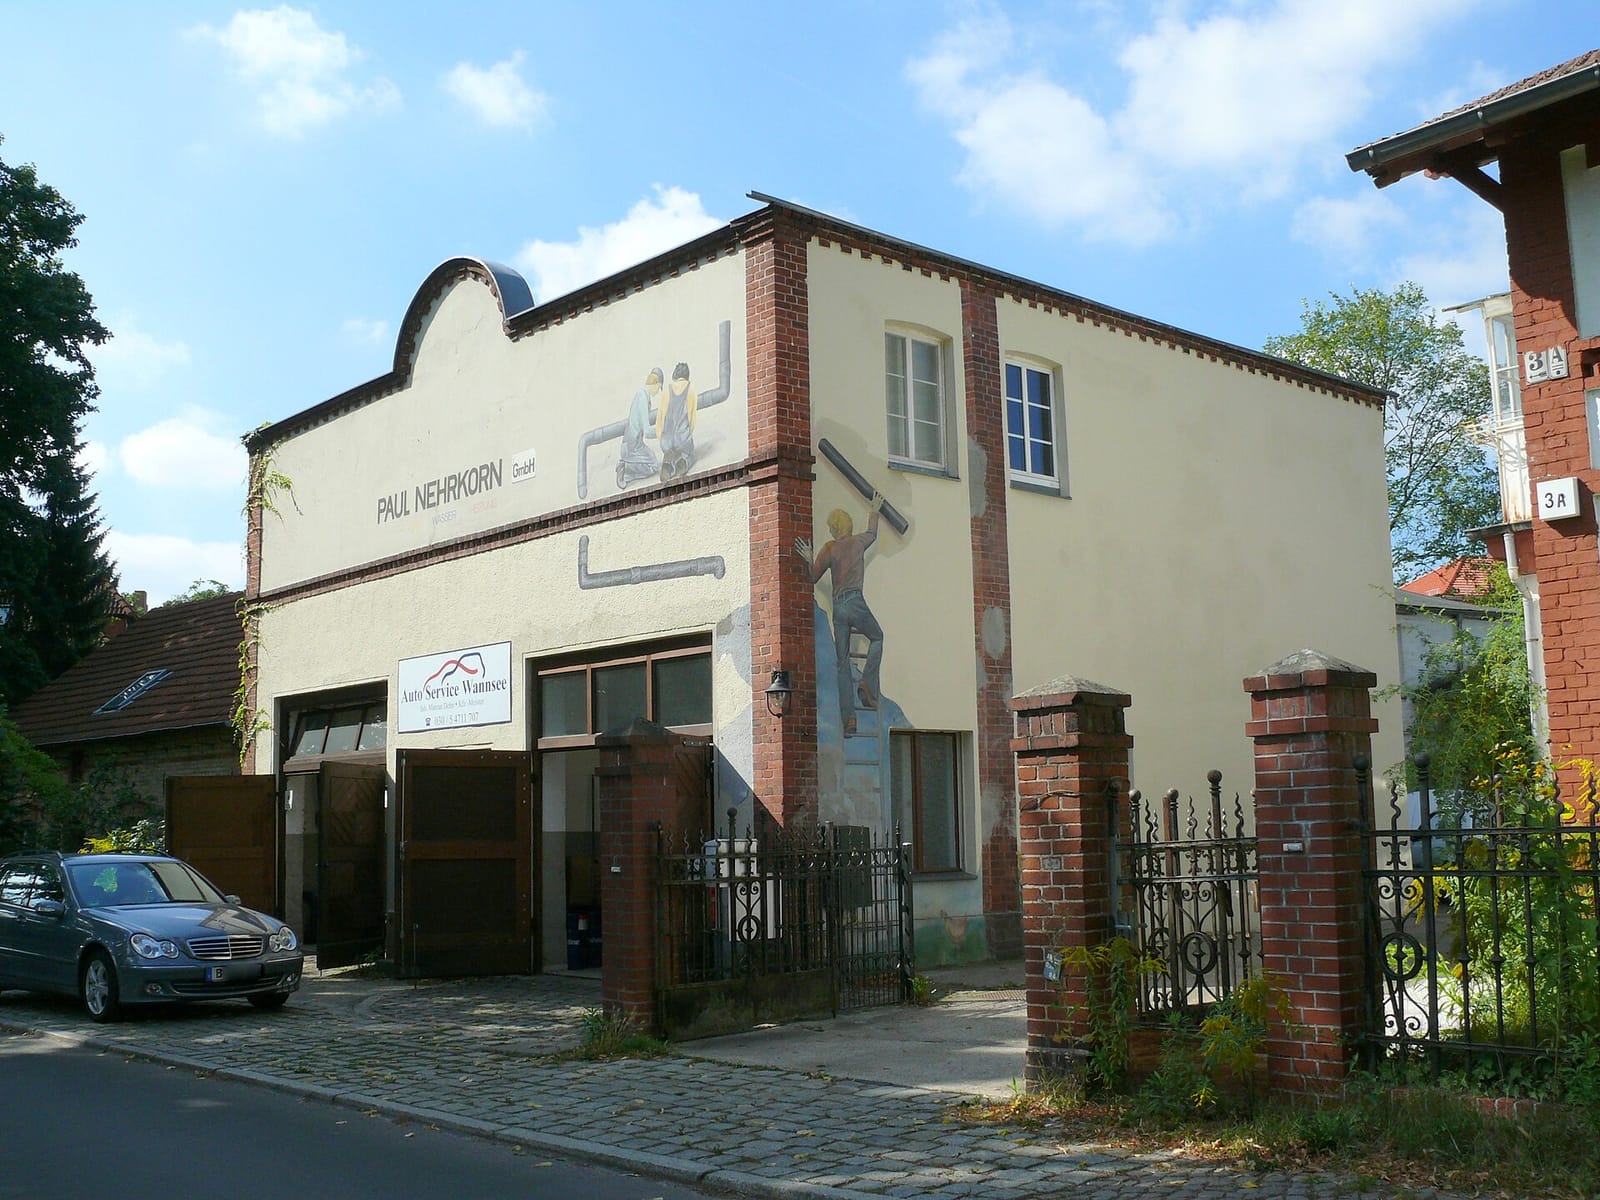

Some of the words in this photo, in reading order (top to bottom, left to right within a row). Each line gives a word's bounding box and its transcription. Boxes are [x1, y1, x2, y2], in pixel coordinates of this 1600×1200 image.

[377, 490, 410, 525] PAUL
[415, 458, 503, 513] NEHRKORN
[512, 457, 535, 478] GmbH
[401, 690, 423, 703] Auto
[425, 682, 460, 700] Service
[462, 678, 507, 695] Wannsee
[215, 968, 223, 979] B
